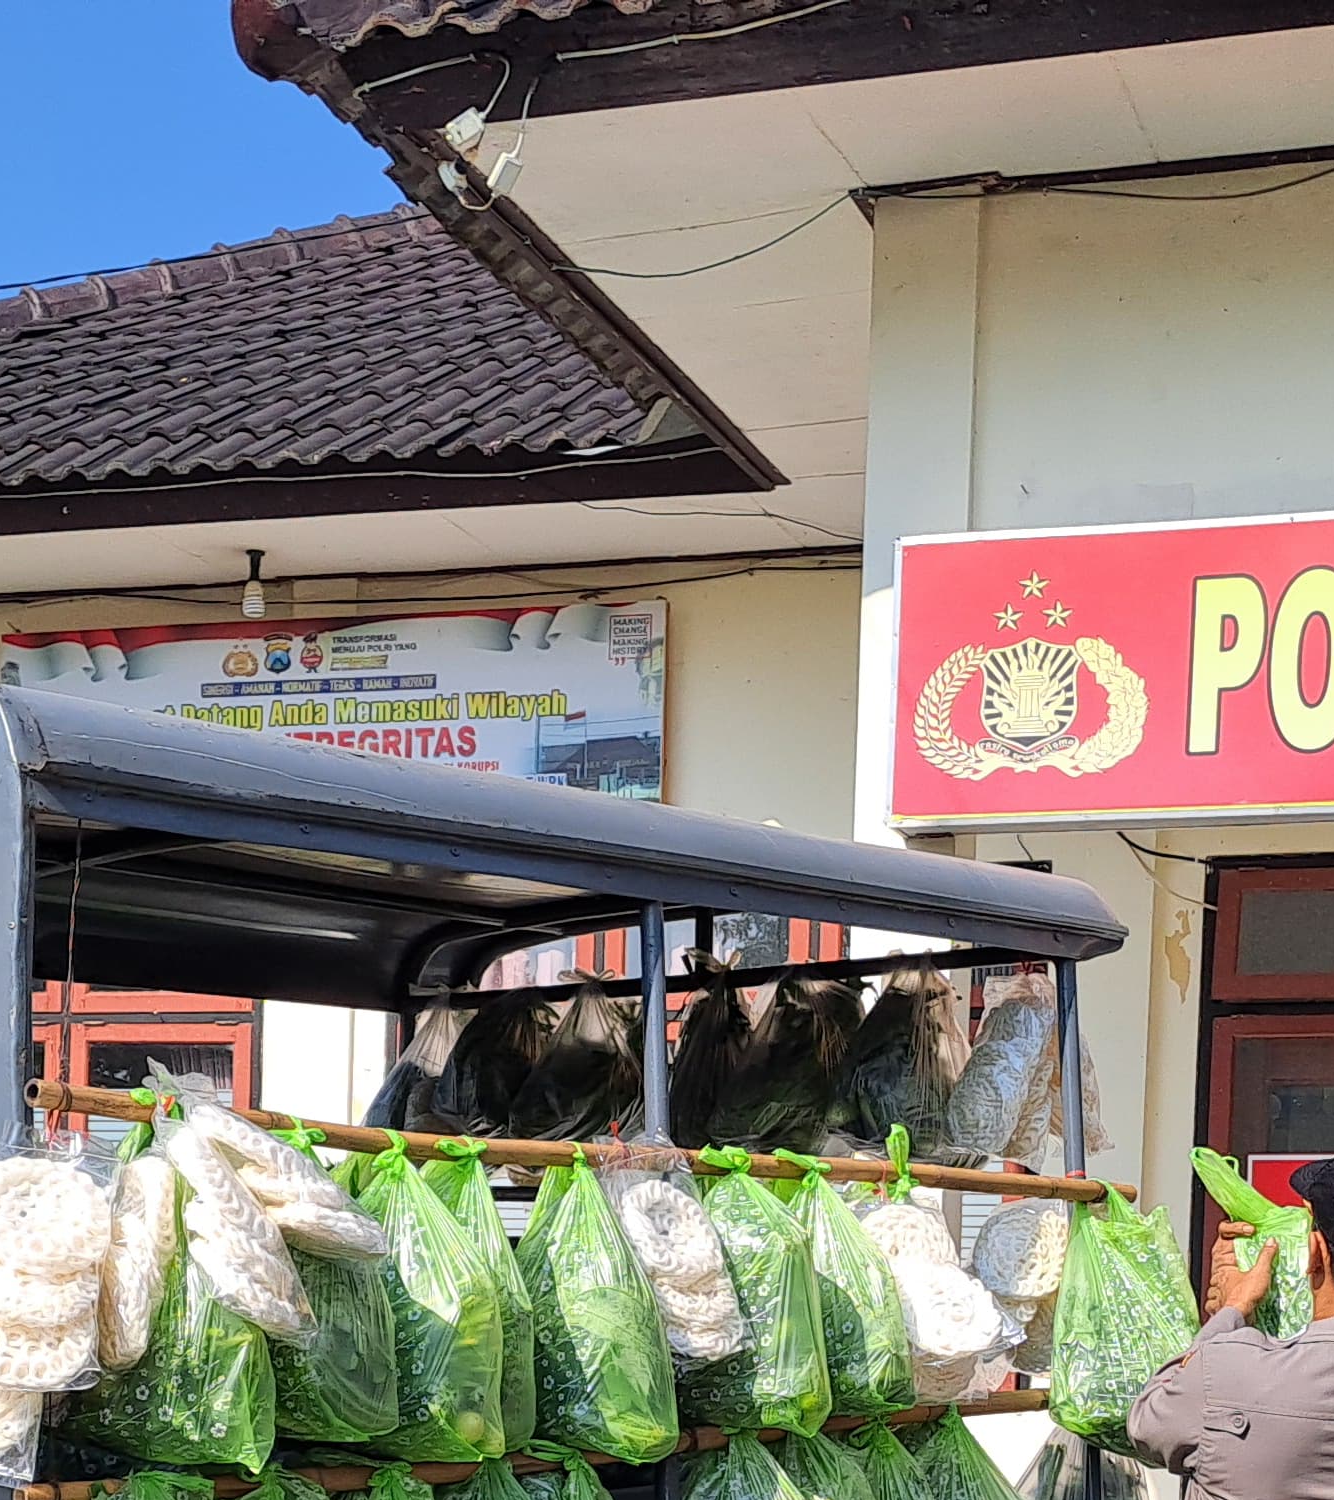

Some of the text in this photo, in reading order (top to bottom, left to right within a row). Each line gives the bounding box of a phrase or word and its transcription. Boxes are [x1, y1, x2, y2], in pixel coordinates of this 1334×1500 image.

[269, 700, 328, 727] Anda
[335, 693, 460, 725] Memasuki
[467, 689, 568, 721] Wilayah
